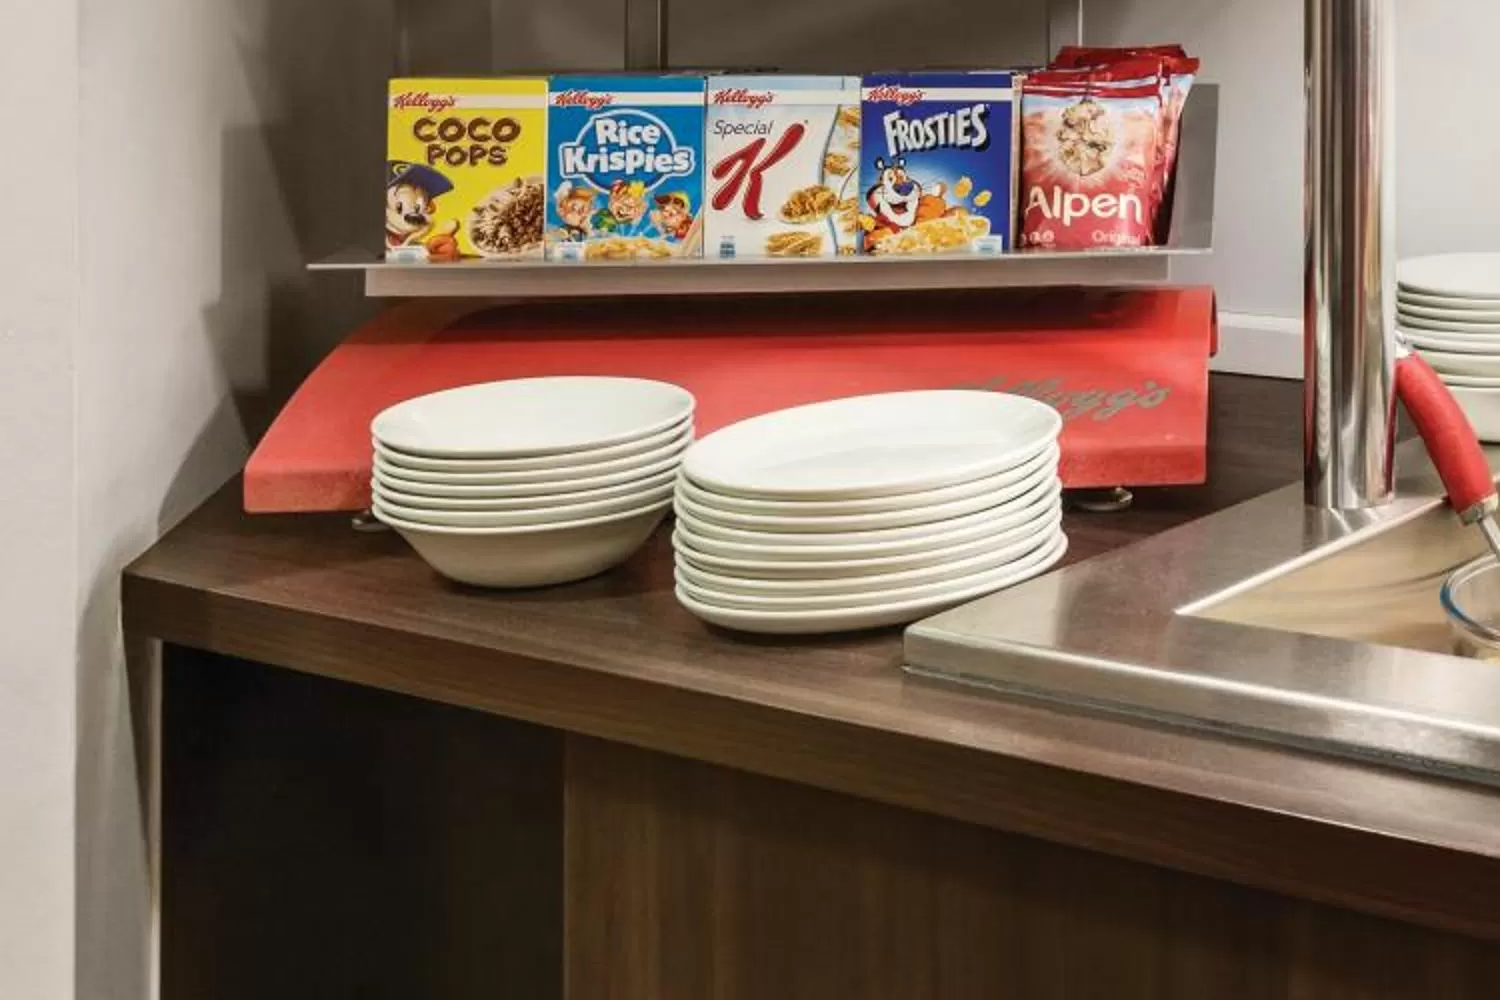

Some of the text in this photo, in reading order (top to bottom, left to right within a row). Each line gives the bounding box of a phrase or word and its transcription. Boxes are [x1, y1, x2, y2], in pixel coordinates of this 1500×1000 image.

[394, 92, 456, 112] Kellogg's
[555, 90, 614, 109] Kellogg's
[713, 88, 775, 108] Kellogg's
[867, 86, 926, 105] Kellogg's
[413, 117, 521, 142] COCO
[595, 119, 661, 147] Rice
[713, 119, 775, 139] Special
[883, 103, 988, 156] FROSTIES
[427, 143, 508, 166] POPS
[564, 145, 694, 177] Krispies
[711, 122, 806, 220] K
[1025, 186, 1142, 227] Alpen
